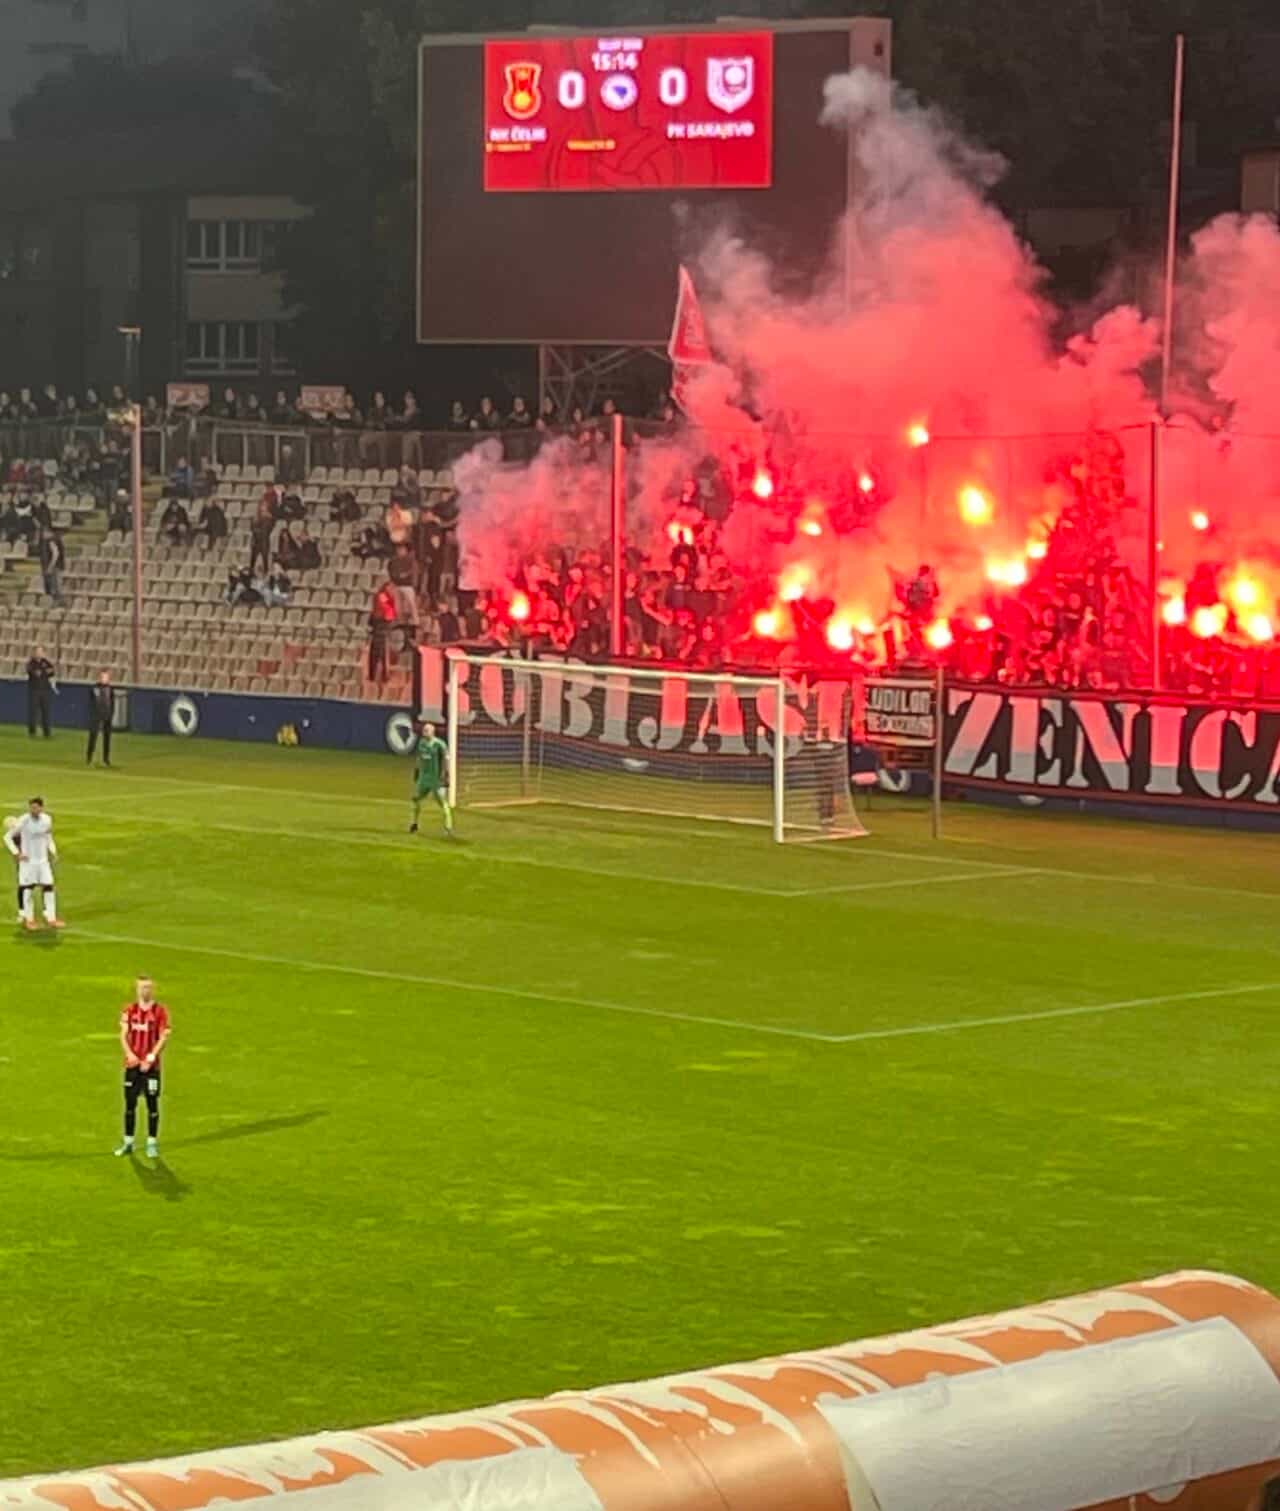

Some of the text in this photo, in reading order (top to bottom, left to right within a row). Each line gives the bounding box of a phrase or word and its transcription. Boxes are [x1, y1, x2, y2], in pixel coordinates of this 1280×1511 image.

[592, 52, 639, 71] 15:14
[558, 69, 586, 109] 0
[659, 67, 688, 107] 0
